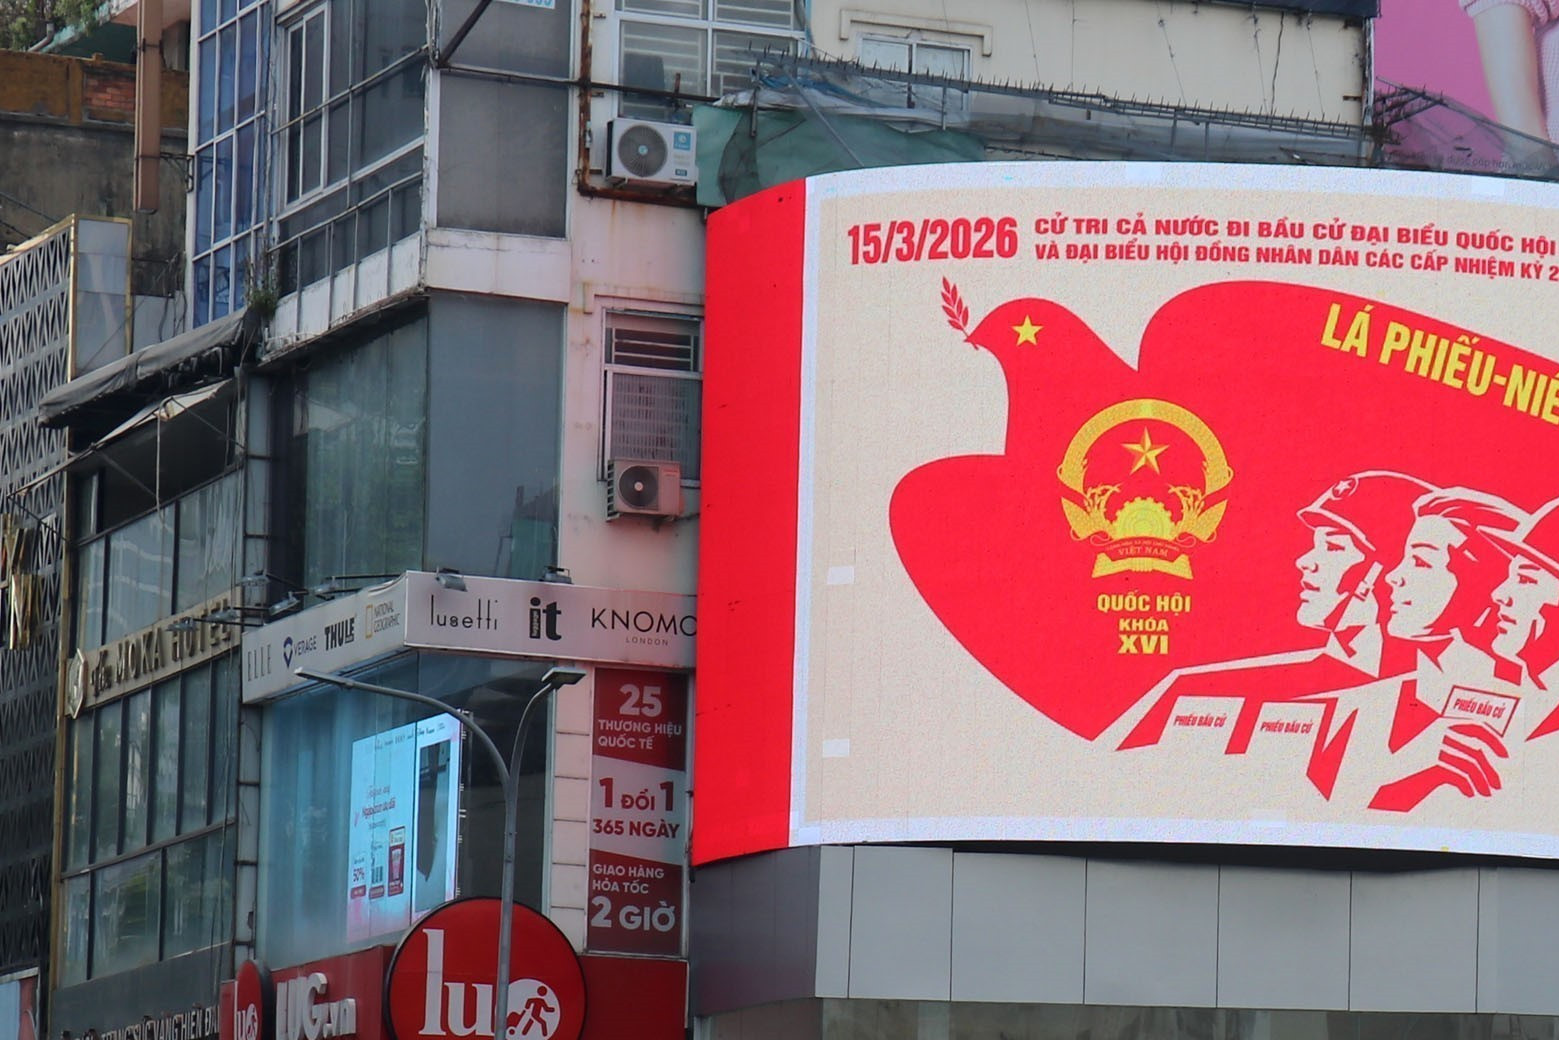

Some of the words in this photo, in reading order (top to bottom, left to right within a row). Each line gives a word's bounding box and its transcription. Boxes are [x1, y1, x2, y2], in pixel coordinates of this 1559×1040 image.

[848, 217, 1019, 265] 15/3/2026
[1034, 211, 1067, 236] CỬ
[1074, 217, 1108, 236] TRI
[1116, 212, 1147, 236] CẢ
[1155, 214, 1219, 238] NƯỚC
[1227, 220, 1250, 238] ĐI
[1258, 216, 1305, 239] BẦU
[1312, 217, 1346, 241] CỬ
[1350, 224, 1390, 246] ĐẠI
[1398, 222, 1449, 247] BIỂU
[1456, 228, 1514, 253] QUỐC
[1521, 233, 1557, 258] HỘI
[1034, 239, 1060, 260] VÀ
[1066, 243, 1099, 265] ĐẠI
[1104, 238, 1150, 260] BIỂU
[1156, 243, 1189, 265] HỘI
[1195, 238, 1250, 263] ĐỒNG
[1256, 244, 1313, 265] NHÂN
[1318, 246, 1360, 267] DÂN
[1365, 247, 1404, 270] CÁC
[1410, 247, 1449, 272] CẤP
[1454, 255, 1516, 280] NHIỆM
[1520, 260, 1544, 282] KỲ
[1320, 303, 1374, 359] LÁ
[430, 594, 498, 631] lusetti
[529, 597, 562, 641] it
[1097, 589, 1151, 614] QUỐC
[1156, 592, 1192, 616] HỘI
[323, 617, 356, 653] THULE
[1118, 615, 1170, 632] KHÓA
[114, 627, 165, 684] MOKA
[625, 636, 669, 647] LONDON
[1117, 634, 1169, 655] XVI
[247, 643, 272, 683] ELLE
[619, 683, 662, 718] 25
[597, 733, 636, 750] QUỐC
[639, 735, 655, 751] TẾ
[598, 718, 651, 734] THƯƠNG
[654, 720, 682, 738] HIỆU
[599, 777, 615, 809] 1
[620, 788, 656, 812] ĐỔI
[659, 781, 674, 811] 1
[592, 818, 625, 836] 365
[628, 818, 681, 839] NGÀY
[592, 863, 626, 878] GIAO
[627, 863, 665, 880] HÀNG
[592, 877, 620, 893] HỎA
[622, 878, 650, 895] TỐC
[590, 895, 613, 929] 2
[618, 900, 676, 933] GIỜ
